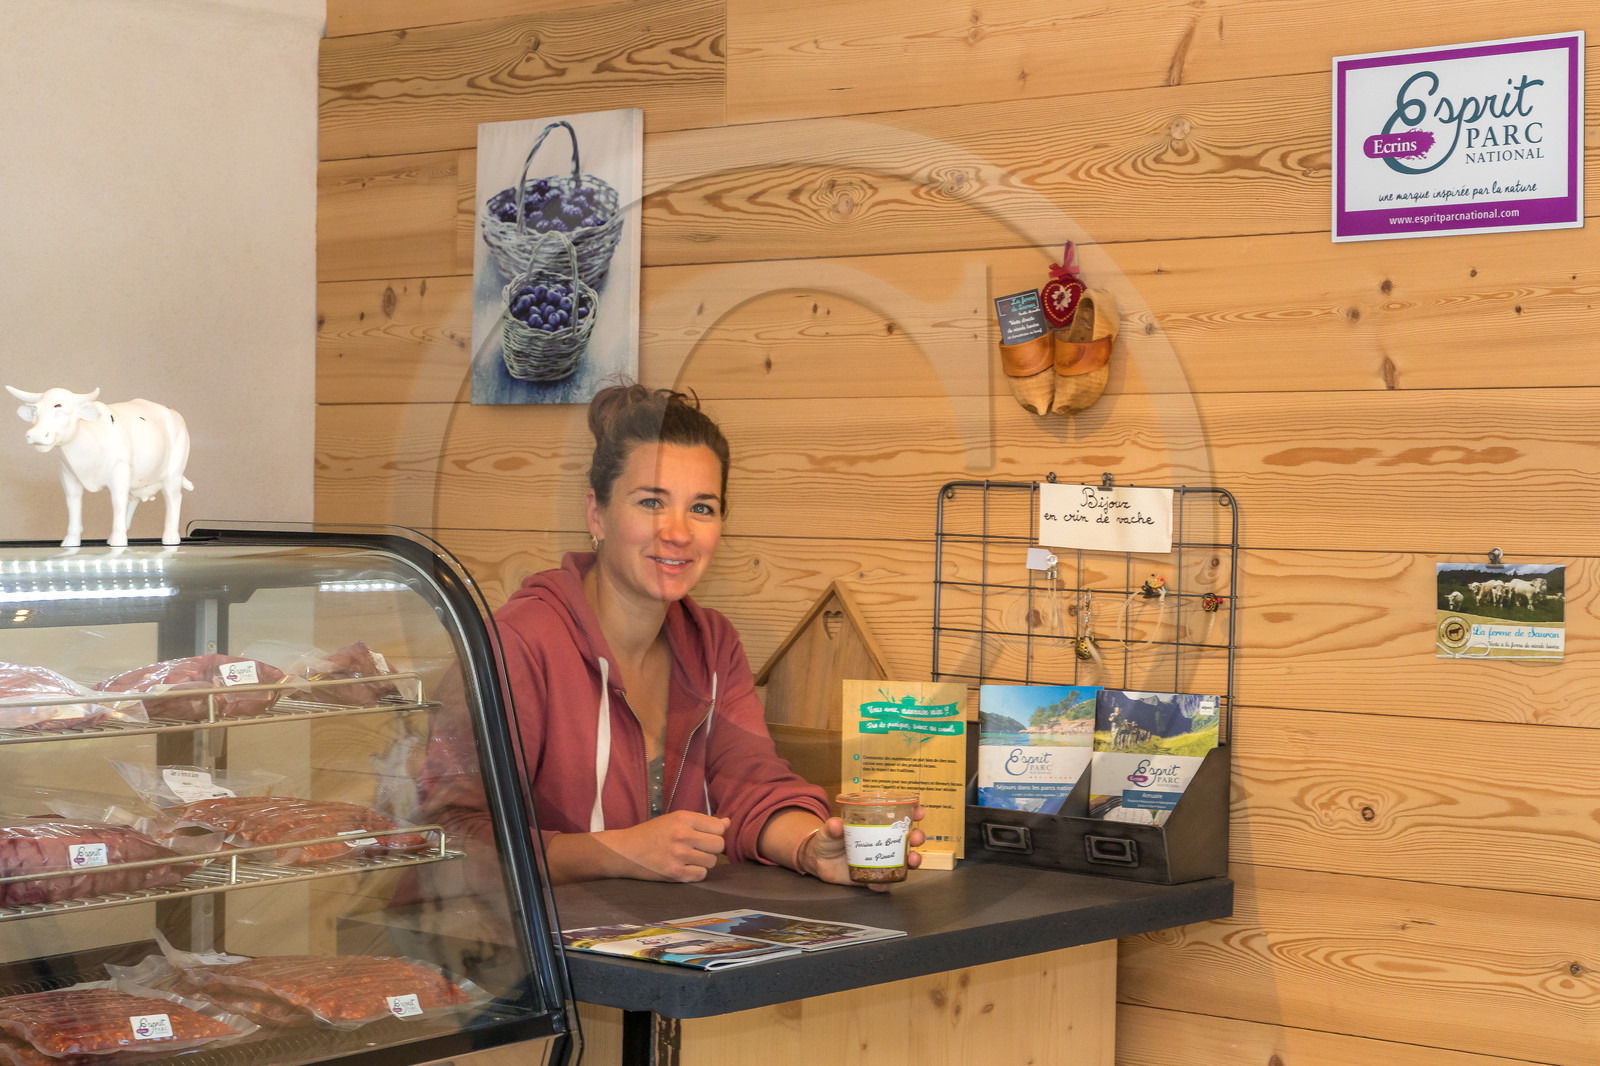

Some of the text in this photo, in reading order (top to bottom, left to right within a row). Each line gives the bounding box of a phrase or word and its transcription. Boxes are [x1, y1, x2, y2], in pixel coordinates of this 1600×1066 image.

[1381, 71, 1544, 174] Esprit
[1373, 138, 1417, 154] Ecrins
[1465, 122, 1543, 149] PARC
[1465, 147, 1545, 165] NATIONAL
[1378, 180, 1537, 202] une marque inspirée par la nature
[1389, 208, 1520, 225] www.espritparcnational.com
[1080, 486, 1131, 515] Bijoux
[1044, 510, 1155, 526] en crin de vache
[1472, 624, 1486, 636] La
[1488, 626, 1512, 640] ferme
[1514, 628, 1524, 637] de
[1005, 748, 1052, 776] Esprit
[1132, 759, 1181, 788] Esprit
